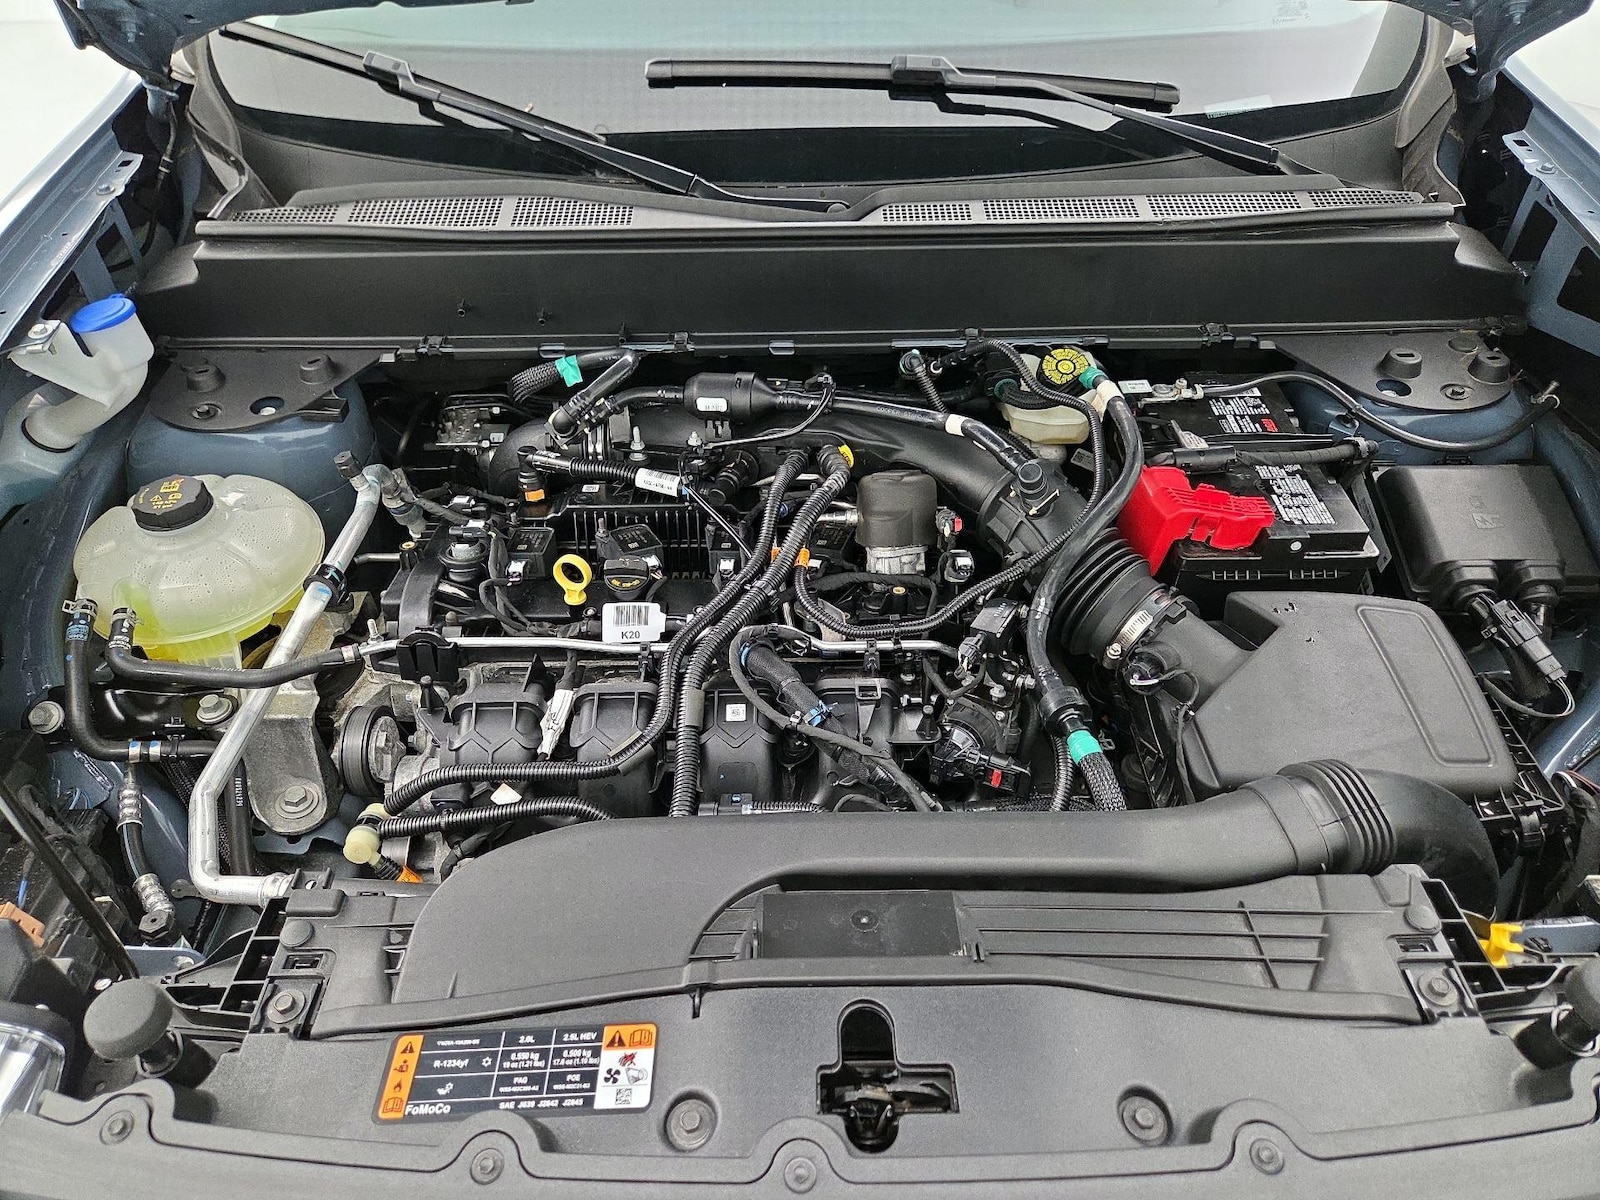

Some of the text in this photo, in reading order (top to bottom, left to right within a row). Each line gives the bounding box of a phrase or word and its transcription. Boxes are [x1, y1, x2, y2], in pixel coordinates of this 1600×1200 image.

[621, 630, 641, 640] K20
[580, 1031, 597, 1041] HEV
[433, 1058, 469, 1069] R-1234yf
[405, 1103, 451, 1116] FoMoCo
[499, 1101, 515, 1110] SAE
